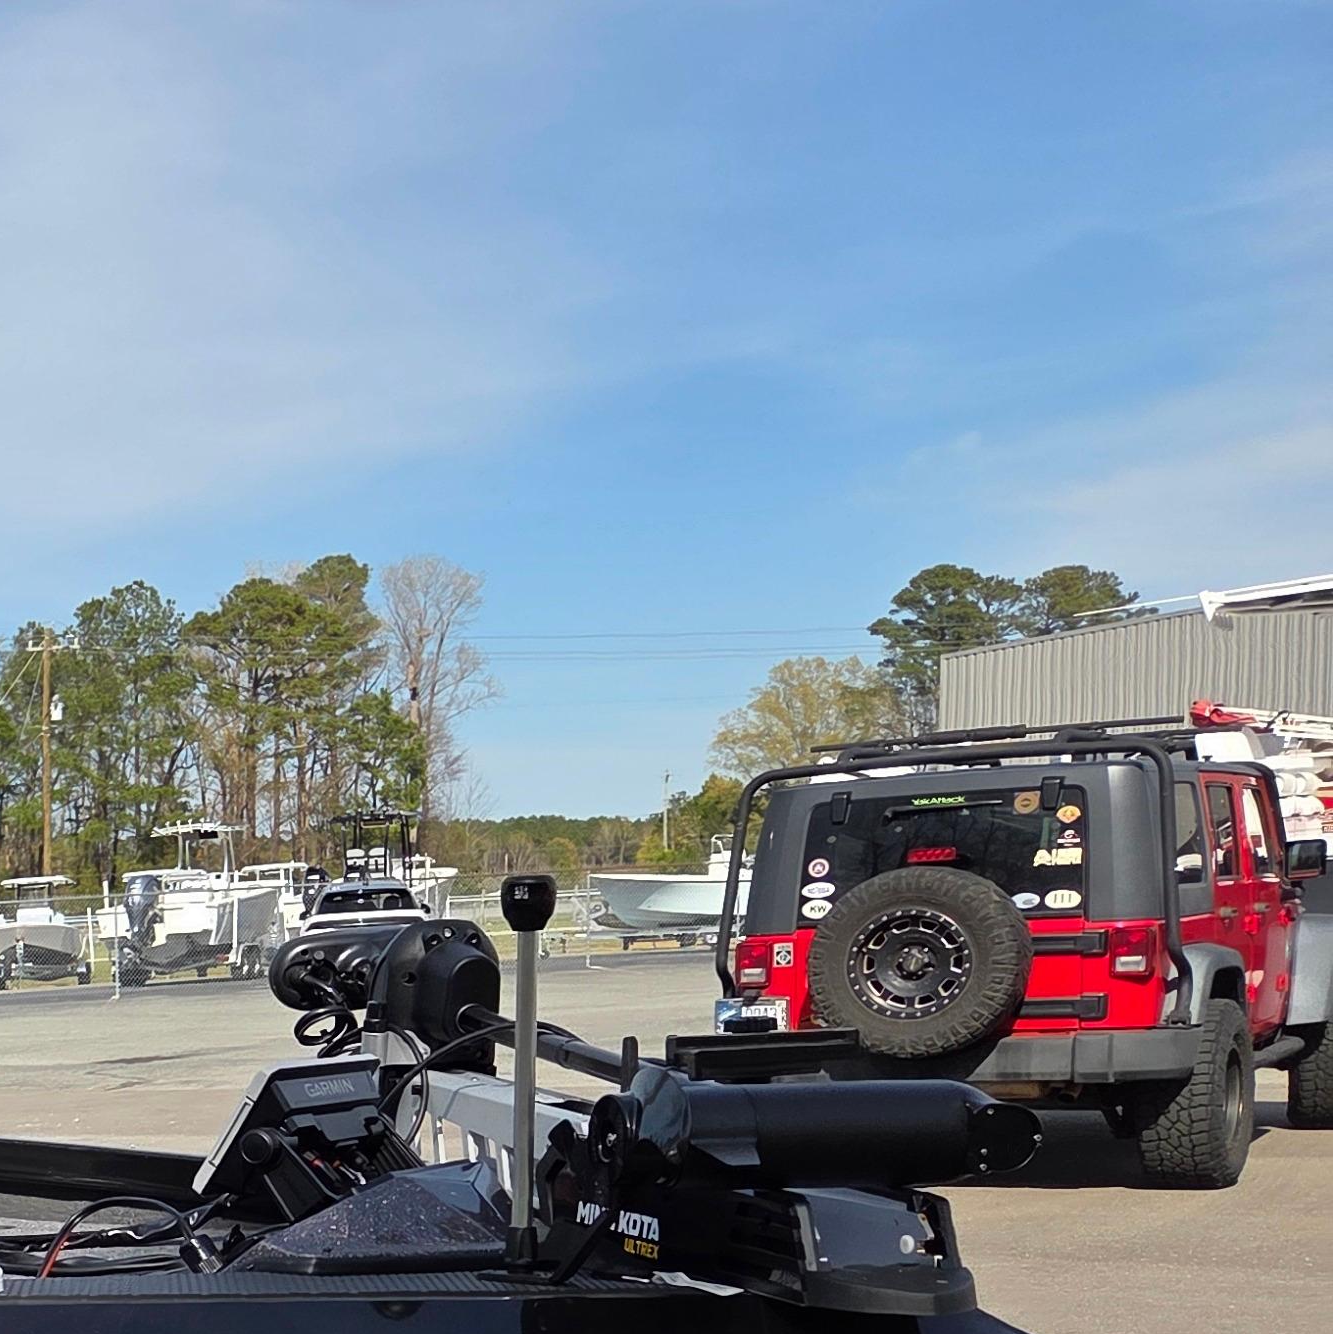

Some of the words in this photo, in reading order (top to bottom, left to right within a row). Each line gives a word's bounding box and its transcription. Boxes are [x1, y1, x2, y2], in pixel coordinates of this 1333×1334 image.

[809, 905, 827, 913] KW
[304, 1078, 355, 1098] GARMIN
[576, 1200, 616, 1231] MI
[617, 1210, 659, 1242] KOTA
[624, 1238, 660, 1260] ULTREX
